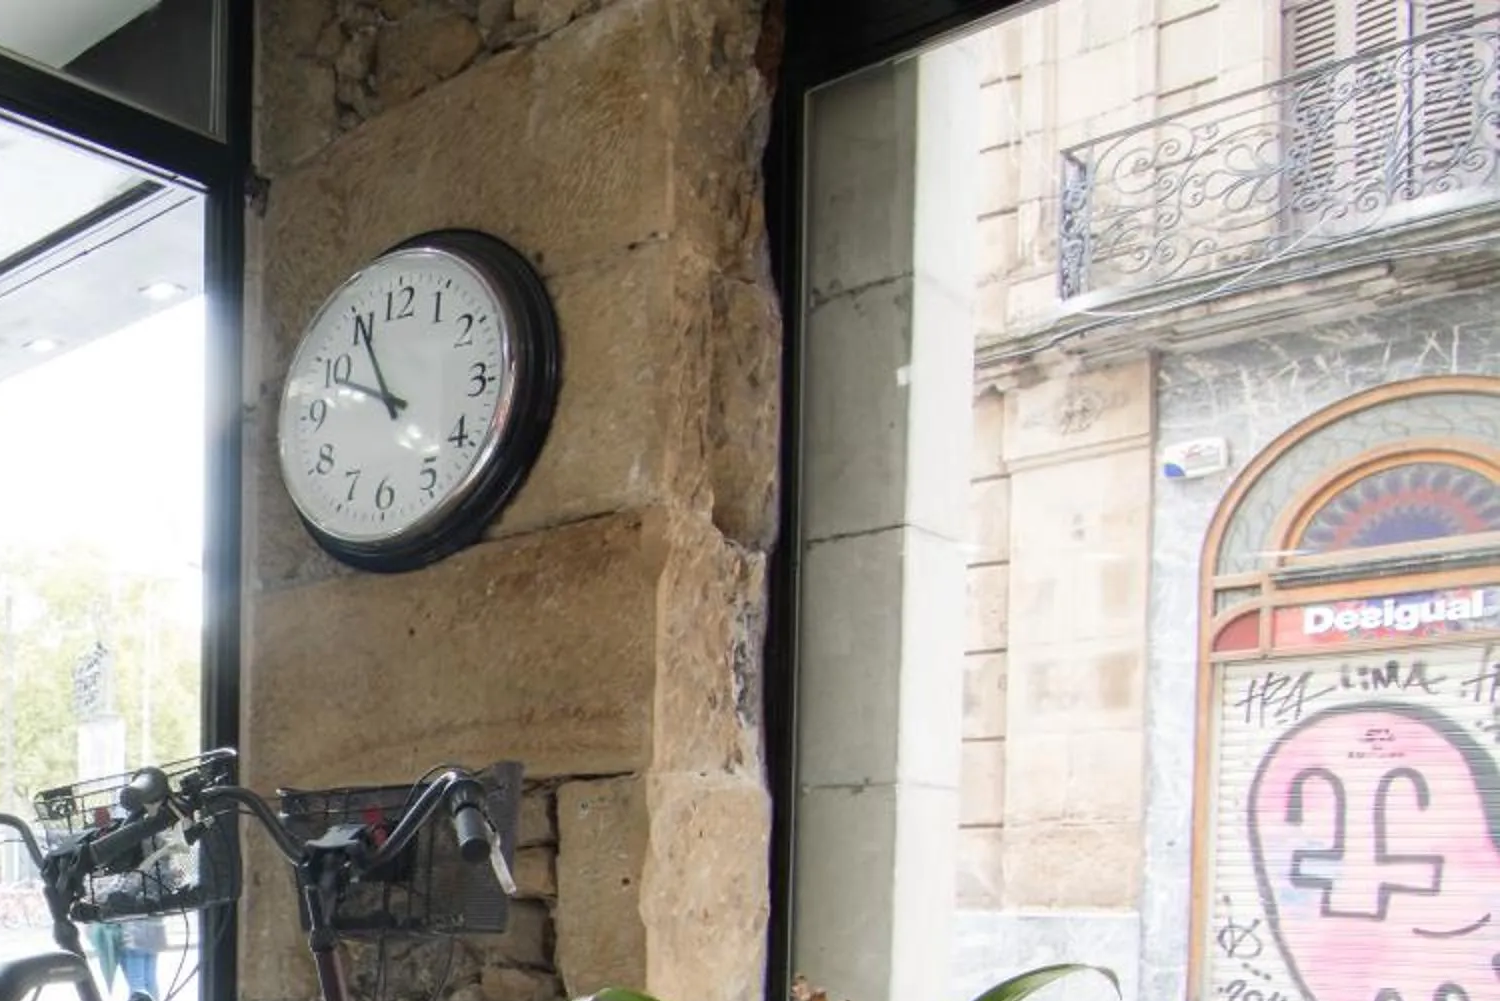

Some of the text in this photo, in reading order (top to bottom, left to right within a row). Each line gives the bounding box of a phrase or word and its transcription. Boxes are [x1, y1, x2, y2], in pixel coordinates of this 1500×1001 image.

[383, 285, 415, 322] 12
[432, 290, 444, 324] 1
[453, 313, 475, 349] 2
[324, 353, 353, 389] 10
[467, 362, 488, 398] 3
[308, 398, 328, 432] 9
[446, 414, 469, 449] 4
[315, 443, 335, 476] 8
[419, 455, 438, 491] 5
[345, 469, 361, 501] 7
[375, 476, 396, 510] 6
[1302, 589, 1485, 635] Desigual
